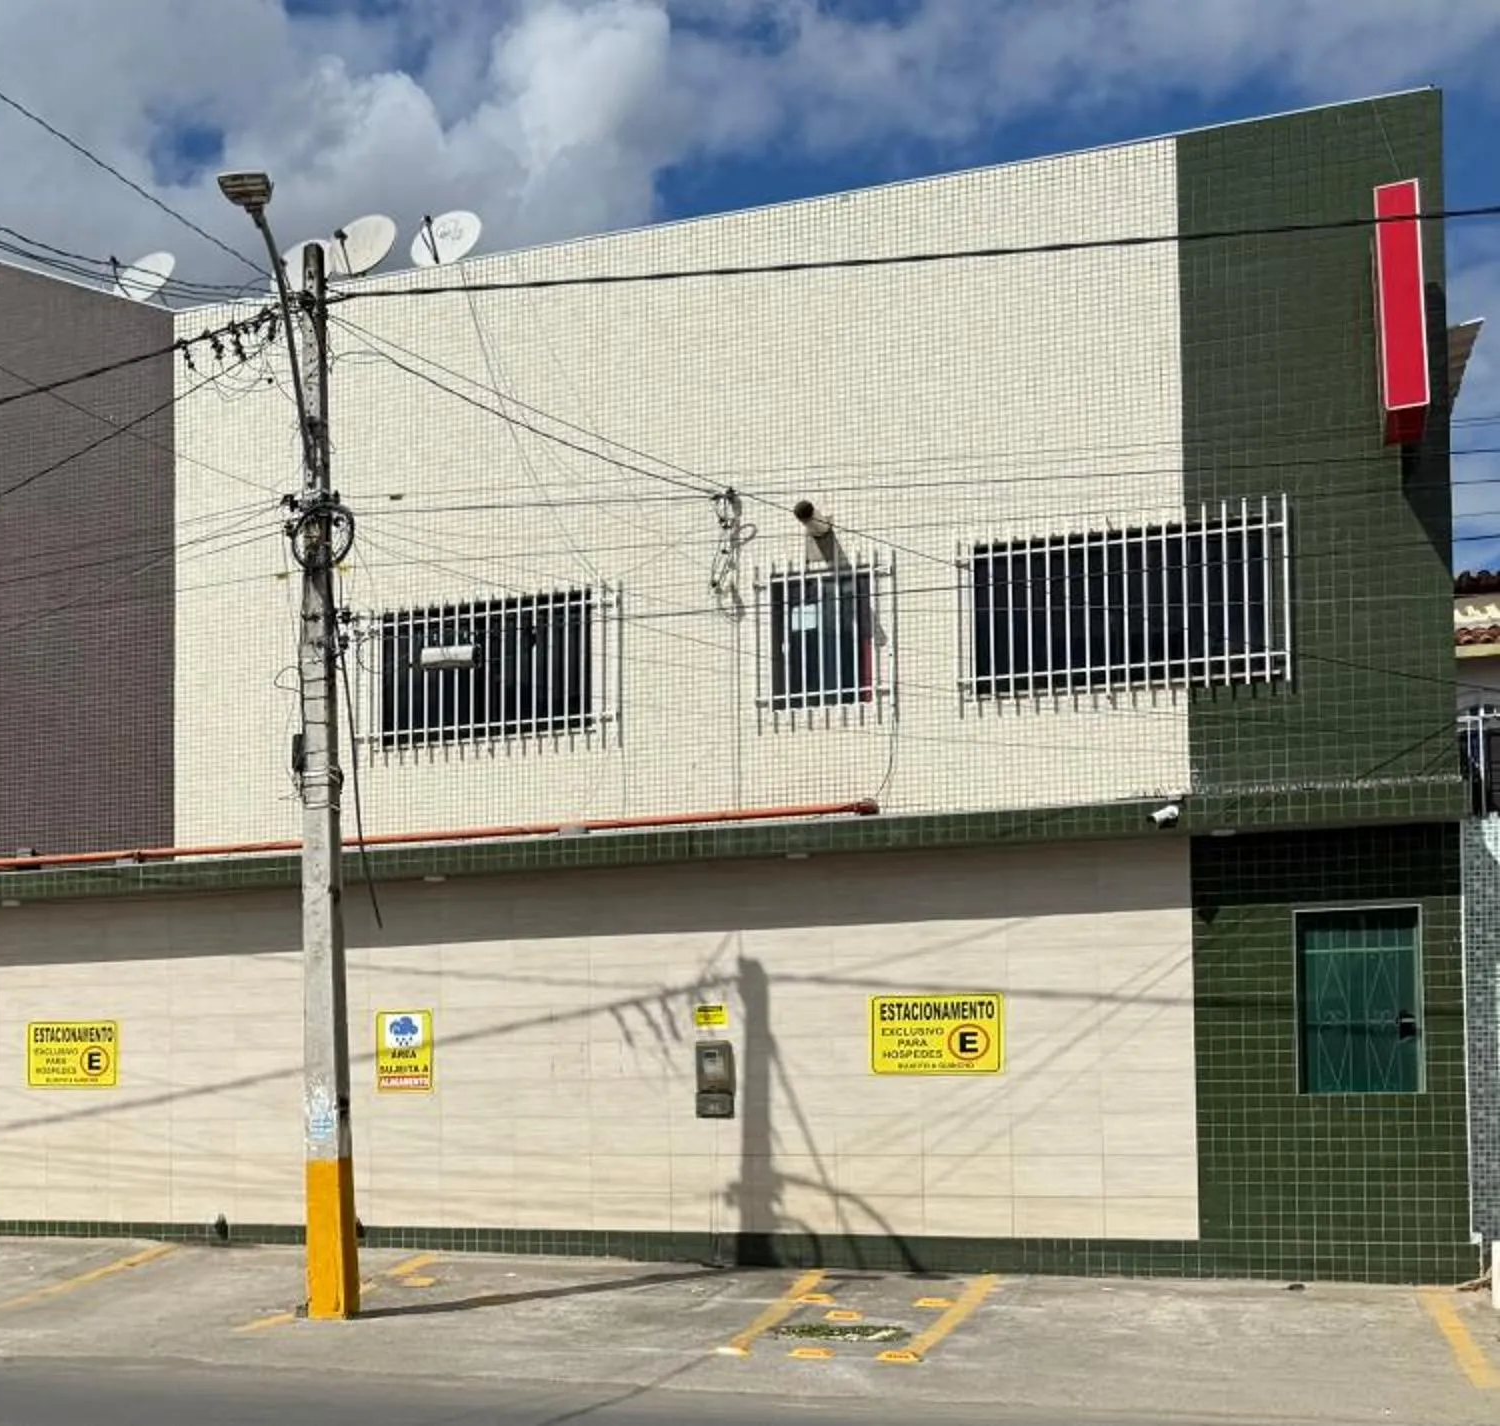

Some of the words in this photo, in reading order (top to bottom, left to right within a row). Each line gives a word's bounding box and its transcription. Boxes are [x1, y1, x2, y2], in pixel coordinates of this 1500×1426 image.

[880, 1001, 994, 1021] ESTACIONAMENTO
[881, 1027, 944, 1037] EXCLUSIVO
[897, 1037, 928, 1048] PARA
[959, 1031, 979, 1053] E
[88, 1052, 101, 1071] E
[883, 1049, 943, 1059] HOSPEDES
